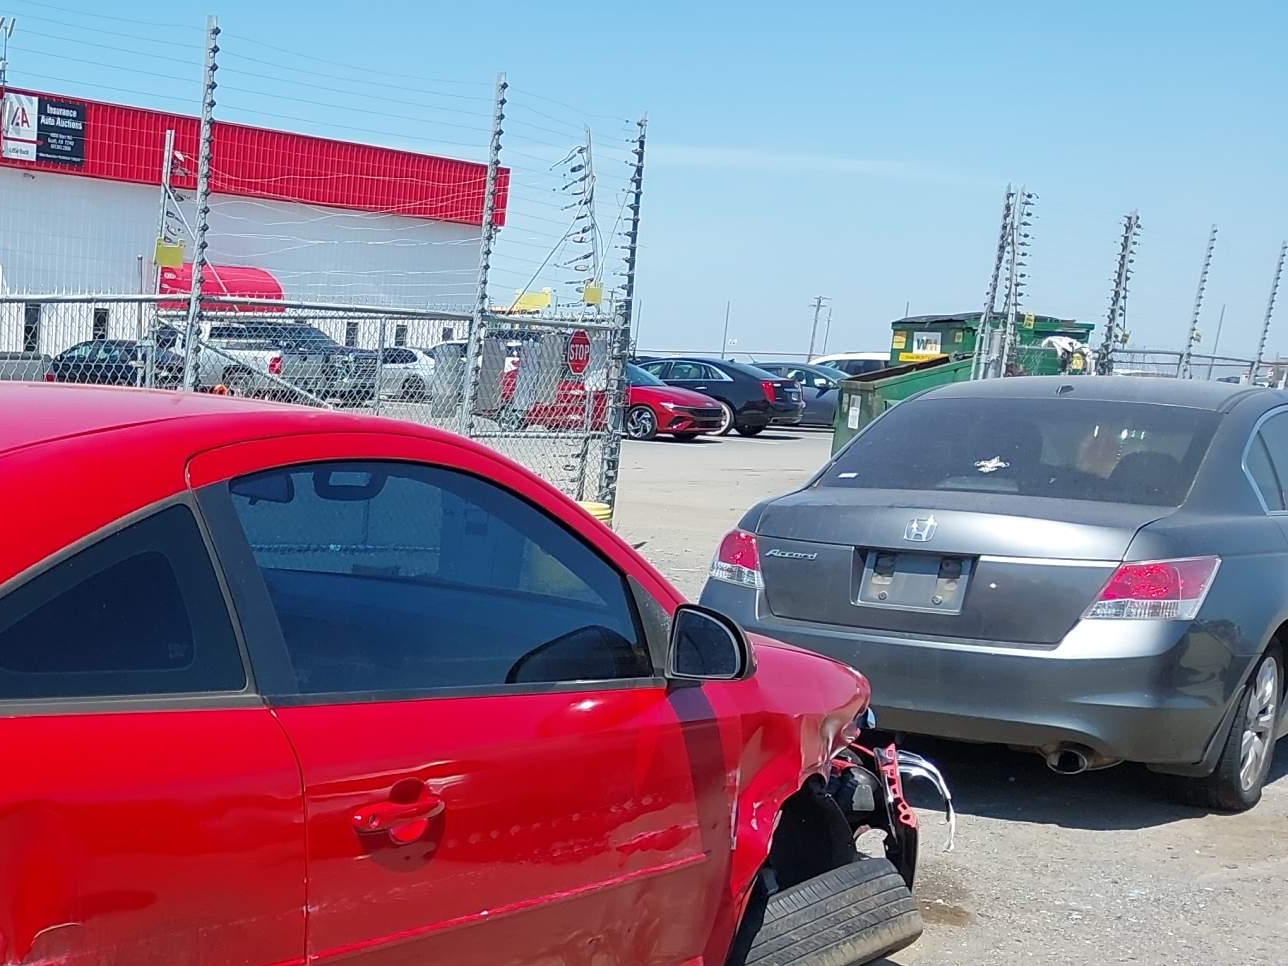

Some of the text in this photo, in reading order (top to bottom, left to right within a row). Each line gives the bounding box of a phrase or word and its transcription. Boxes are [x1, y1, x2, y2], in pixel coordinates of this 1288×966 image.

[46, 103, 77, 118] Insurance
[40, 114, 83, 130] Auto Auctions
[569, 343, 590, 361] STOP
[765, 548, 818, 561] Accord
